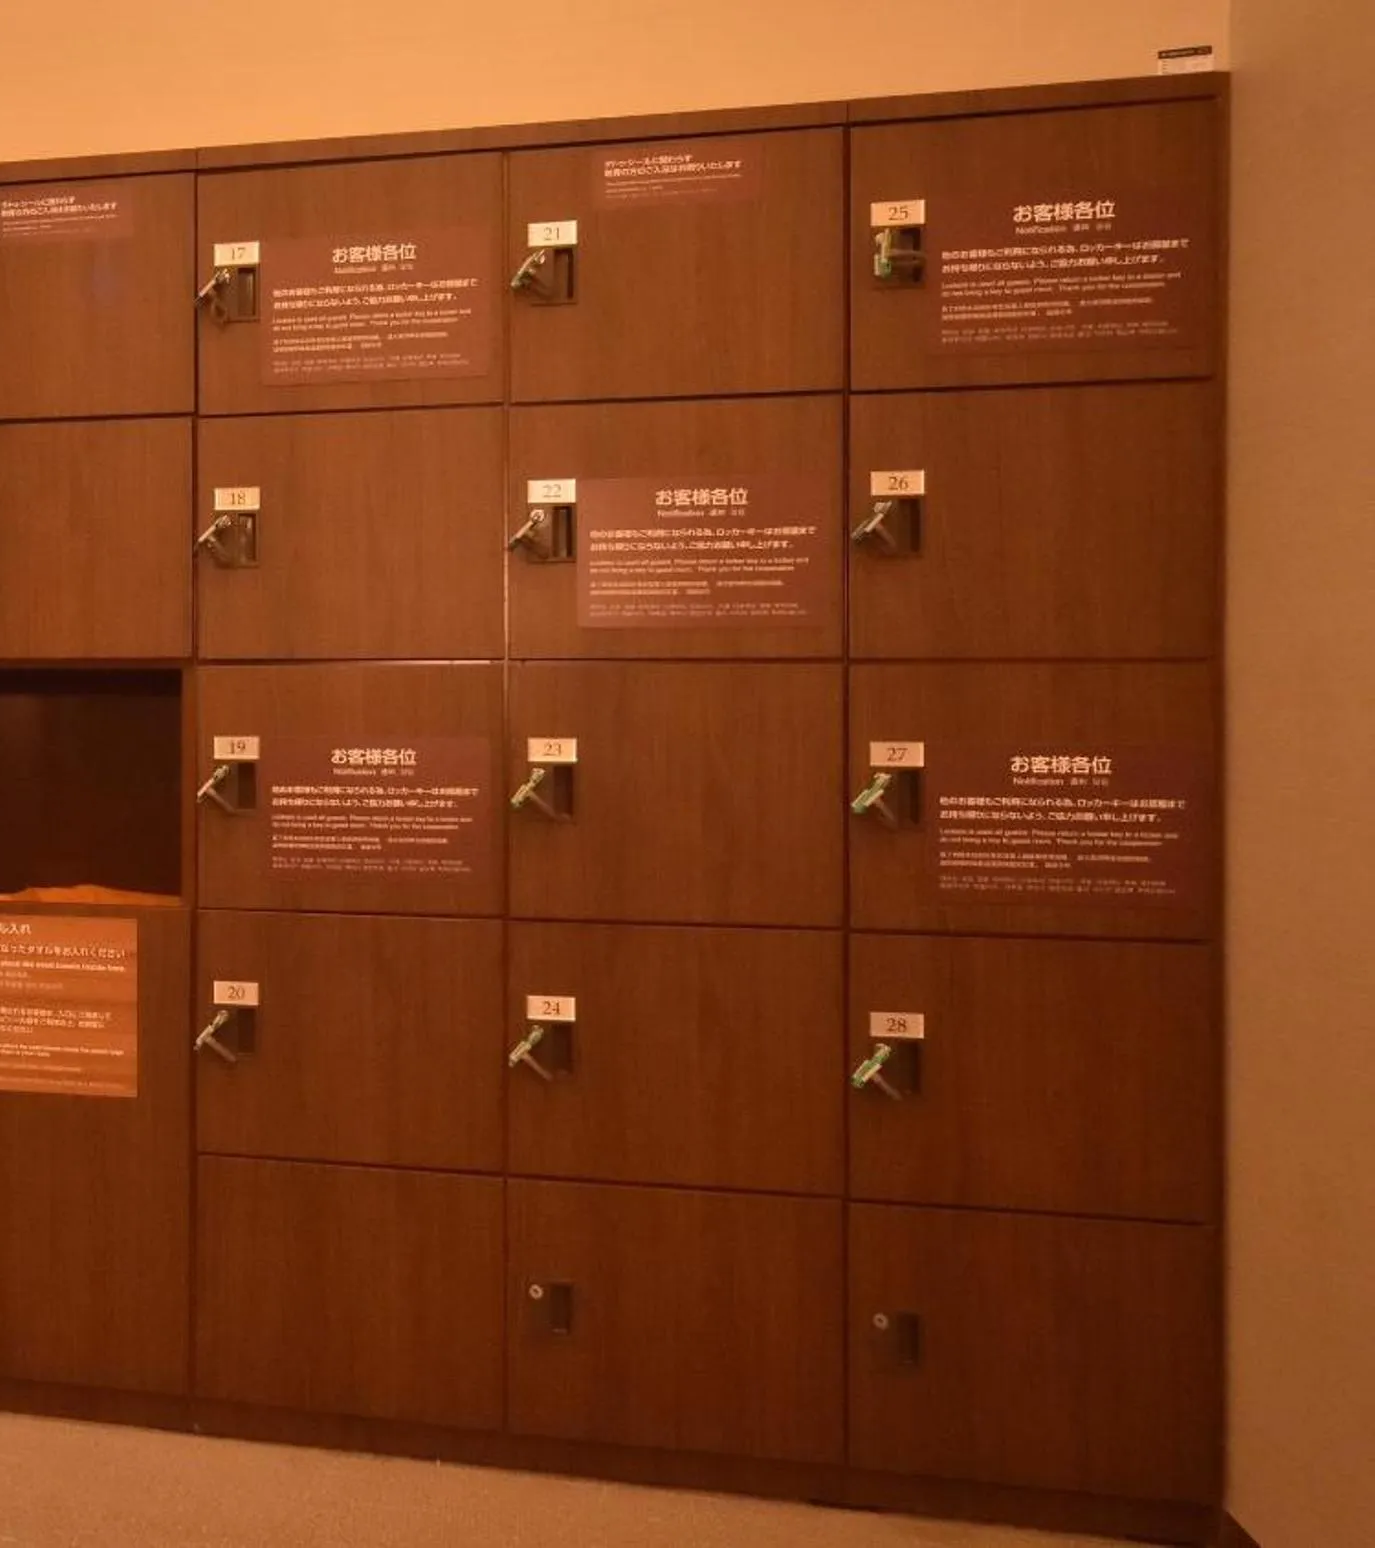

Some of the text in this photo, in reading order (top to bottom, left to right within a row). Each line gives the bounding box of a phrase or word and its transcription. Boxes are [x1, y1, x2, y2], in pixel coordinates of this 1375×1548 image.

[888, 206, 909, 222] 25
[1012, 199, 1116, 223] お客様各位
[543, 226, 561, 241] 21
[230, 246, 246, 261] 17
[331, 242, 417, 264] お客様各位
[542, 483, 562, 498] 22
[888, 475, 910, 491] 26
[230, 491, 246, 505] 18
[654, 487, 749, 507] お客様各位
[230, 740, 246, 754] 19
[543, 741, 562, 757] 23
[887, 747, 909, 762] 27
[330, 747, 418, 767] お客様各位
[1010, 755, 1112, 775] お客様各位
[228, 986, 246, 1000] 20
[542, 1000, 561, 1015] 24
[886, 1017, 908, 1033] 28
